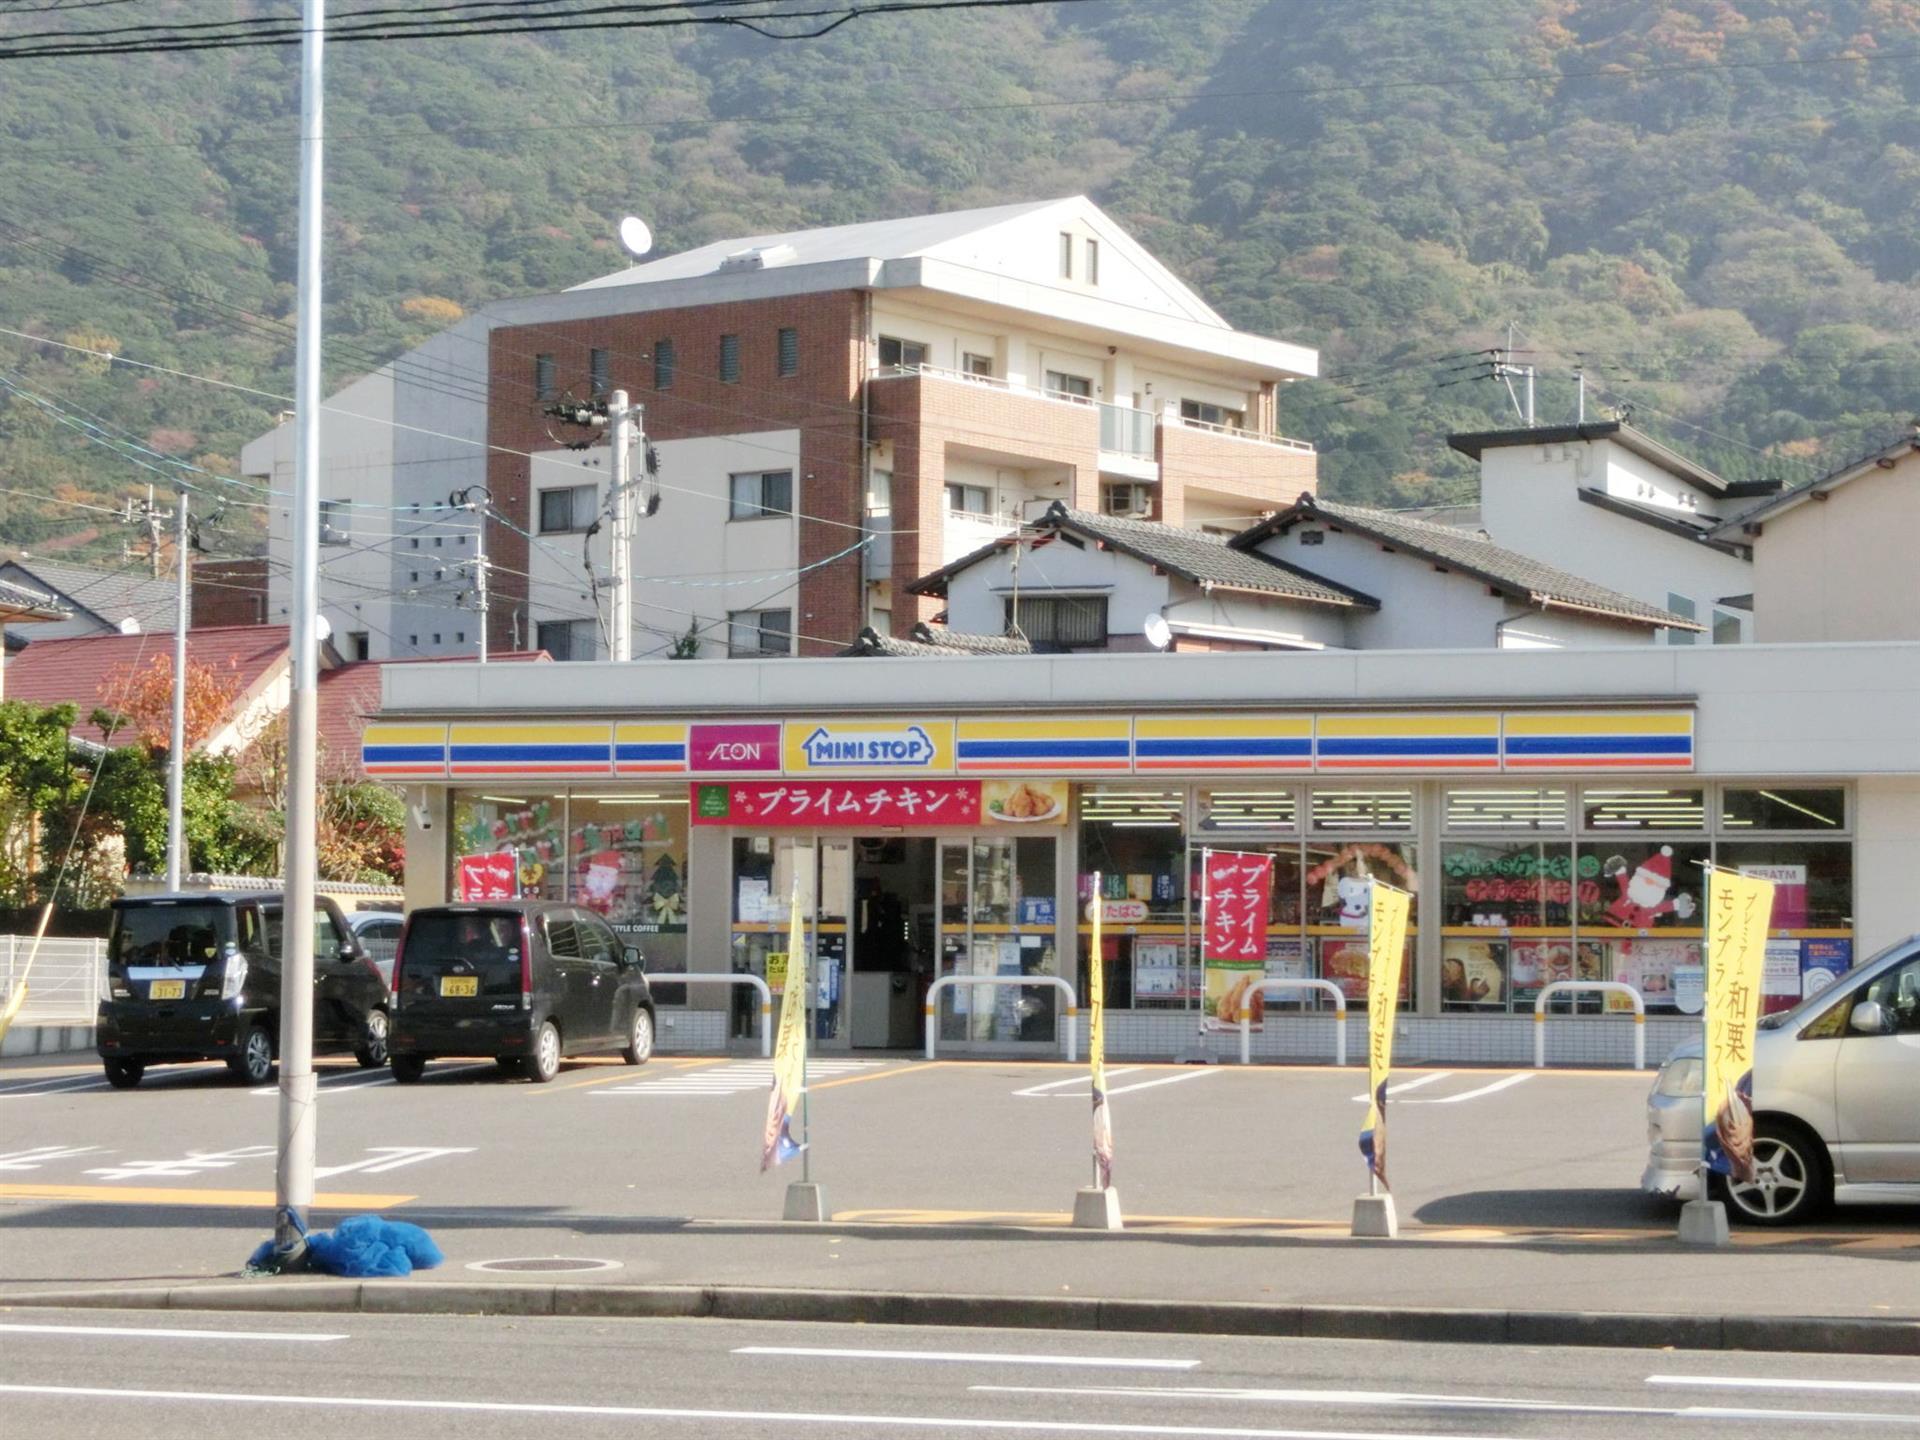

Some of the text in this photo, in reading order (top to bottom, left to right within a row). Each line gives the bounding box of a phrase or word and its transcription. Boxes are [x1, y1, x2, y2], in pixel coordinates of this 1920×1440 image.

[815, 740, 922, 760] MINI STOP
[758, 787, 950, 816] プライムチキン
[1214, 887, 1237, 953] チキン
[1240, 865, 1264, 954] プライム
[612, 924, 659, 933] TYLE COFFEE
